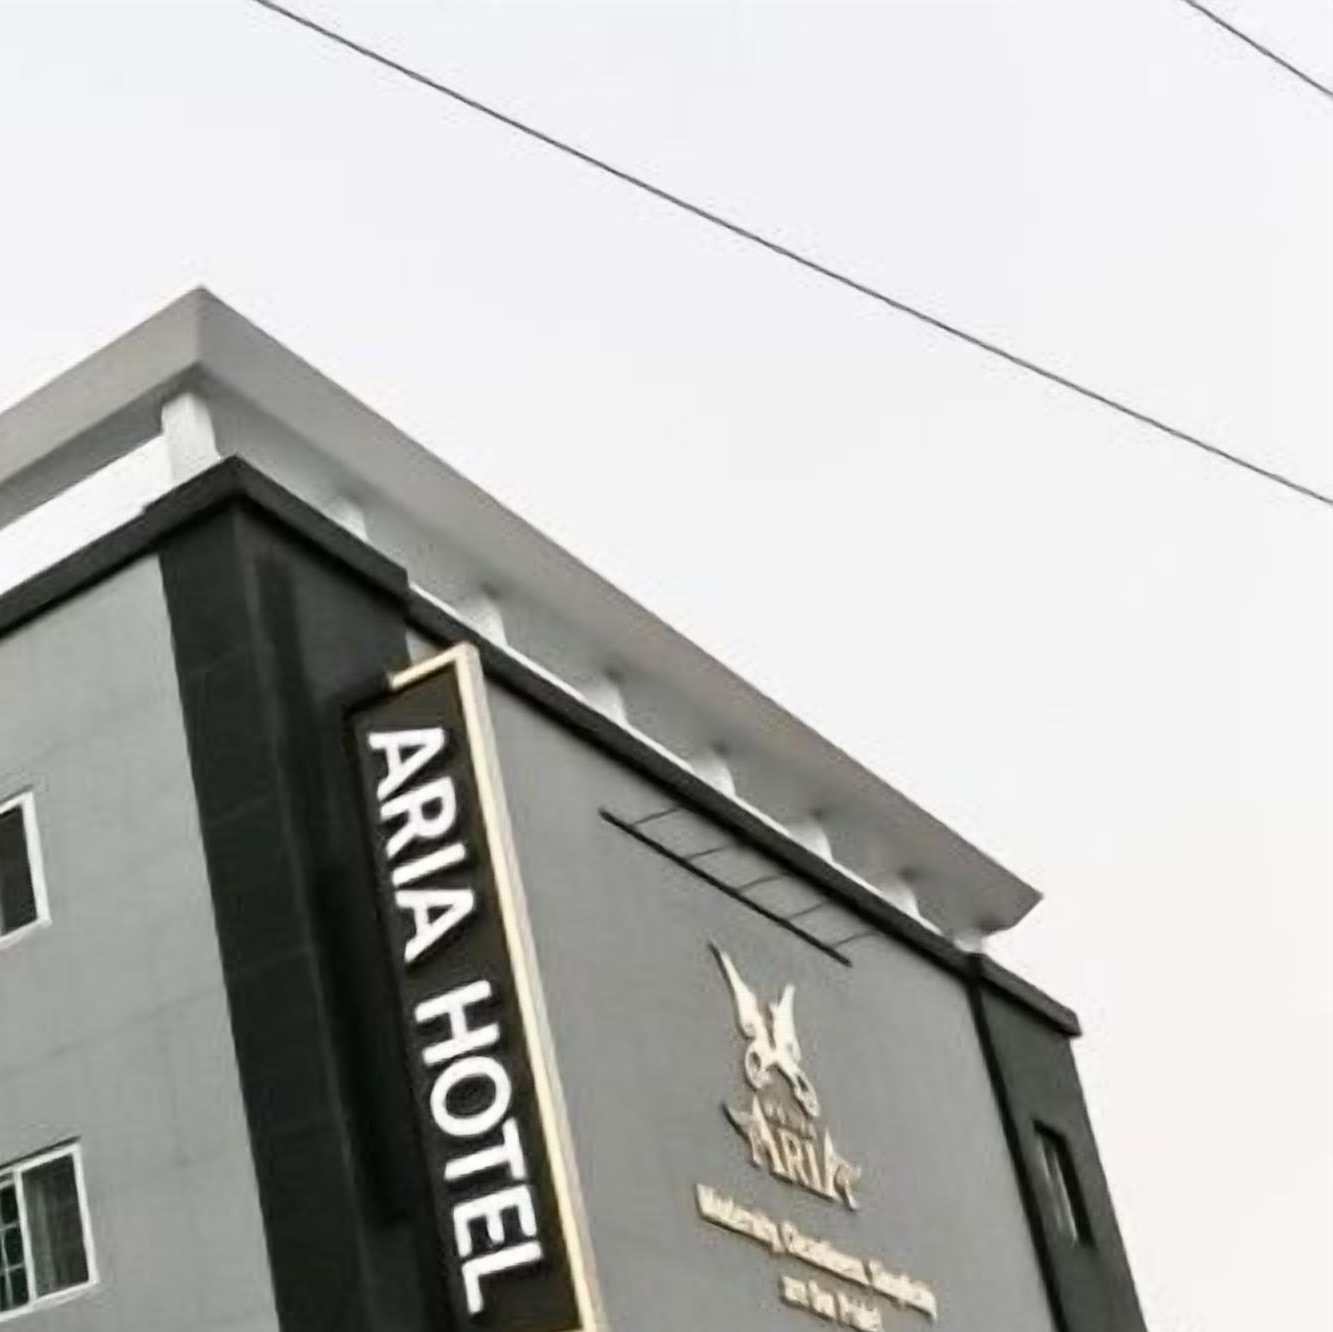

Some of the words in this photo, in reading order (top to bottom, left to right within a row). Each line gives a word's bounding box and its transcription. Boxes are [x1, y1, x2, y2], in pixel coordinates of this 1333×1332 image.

[367, 726, 476, 965] ARIA
[413, 978, 545, 1315] HOTEL
[725, 1094, 861, 1210] ARIA
